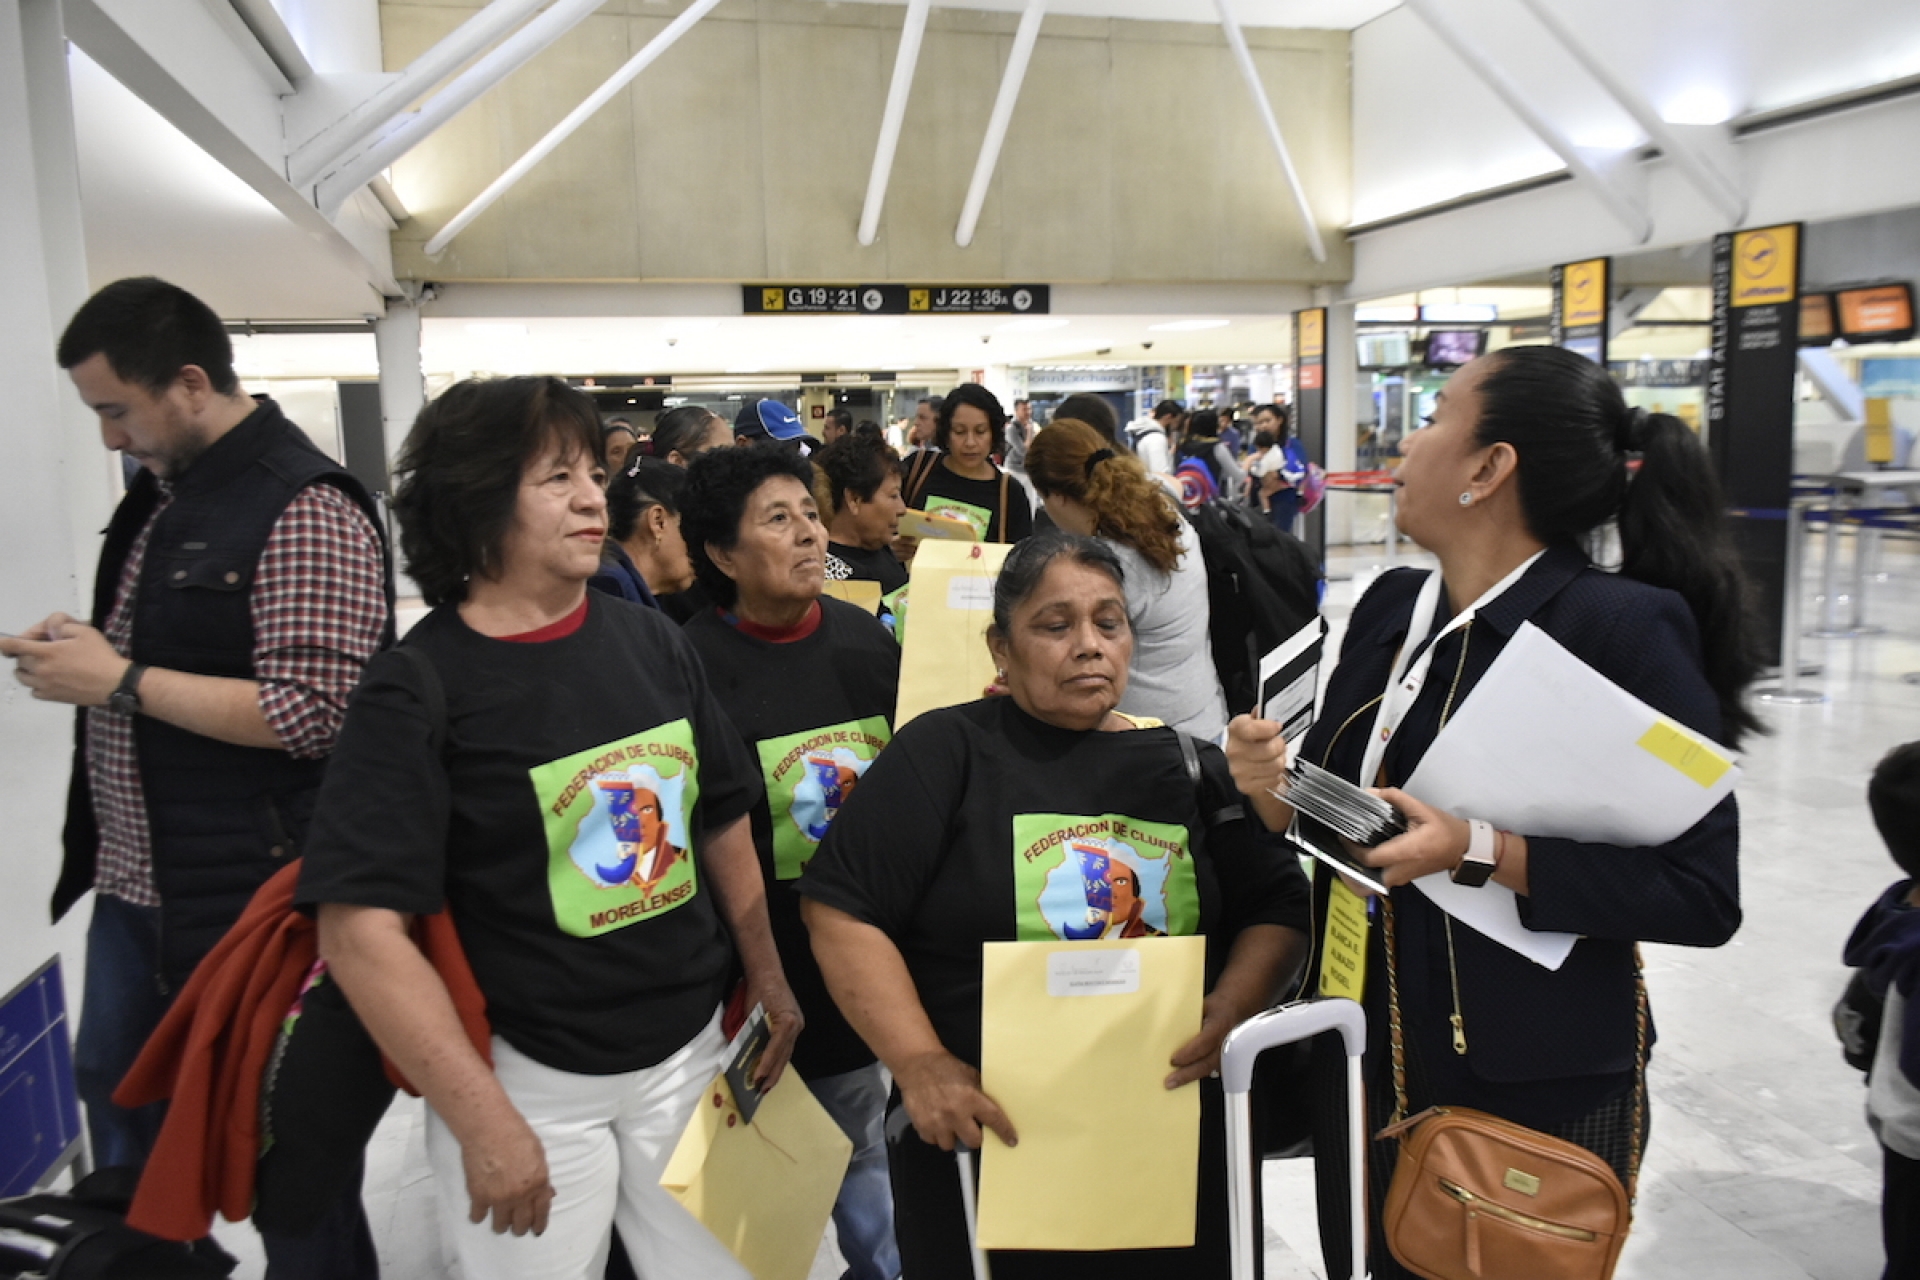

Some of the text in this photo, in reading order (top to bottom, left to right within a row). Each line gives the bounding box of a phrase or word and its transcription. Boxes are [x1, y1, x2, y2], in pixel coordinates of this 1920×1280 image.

[788, 288, 803, 305] G
[935, 289, 946, 305] J
[1708, 260, 1729, 421] STAR ALLIANCE
[551, 748, 626, 818] FEDERACION
[626, 743, 646, 759] DE
[772, 733, 832, 782] FEDERACION
[833, 730, 848, 743] DE
[1023, 820, 1109, 863] FEDERACION
[1112, 820, 1128, 838] DE
[590, 879, 692, 929] MORELENSES
